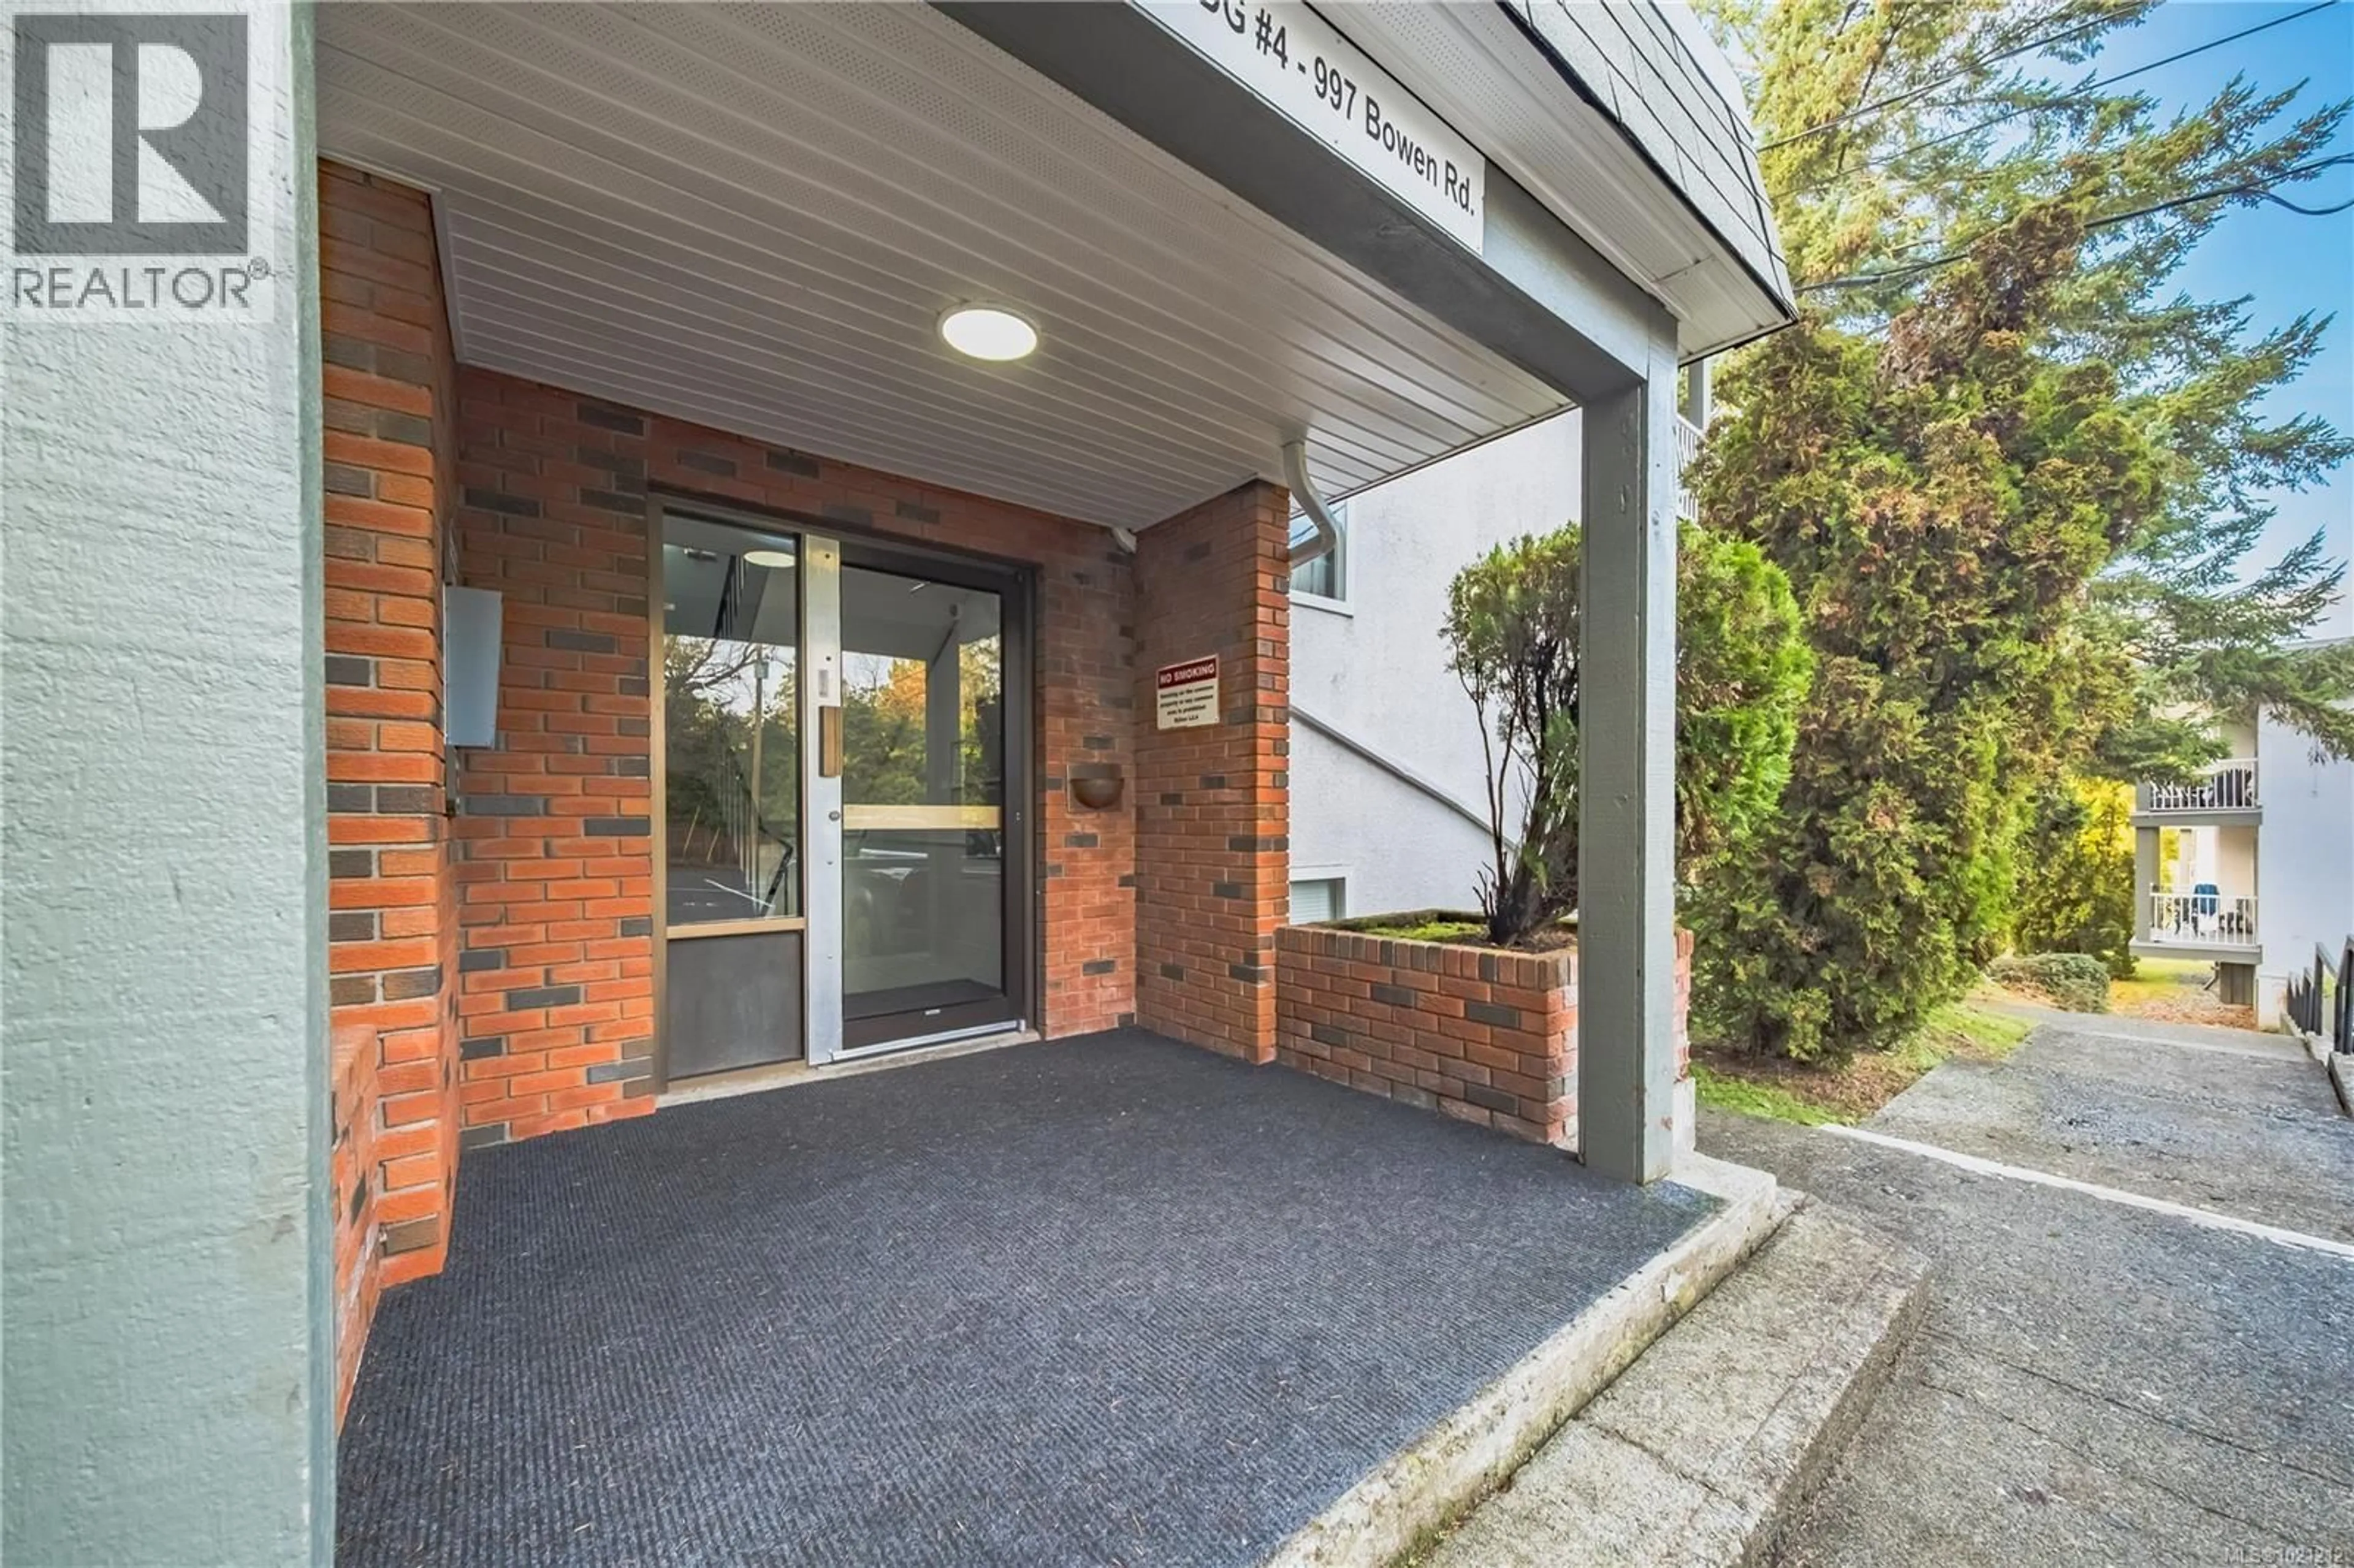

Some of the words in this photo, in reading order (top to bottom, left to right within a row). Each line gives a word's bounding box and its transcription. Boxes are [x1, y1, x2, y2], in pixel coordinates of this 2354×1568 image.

[1254, 8, 1288, 69] #4
[1314, 56, 1357, 120] 997
[1366, 94, 1438, 187] Bowen
[1444, 159, 1474, 216] Rd.
